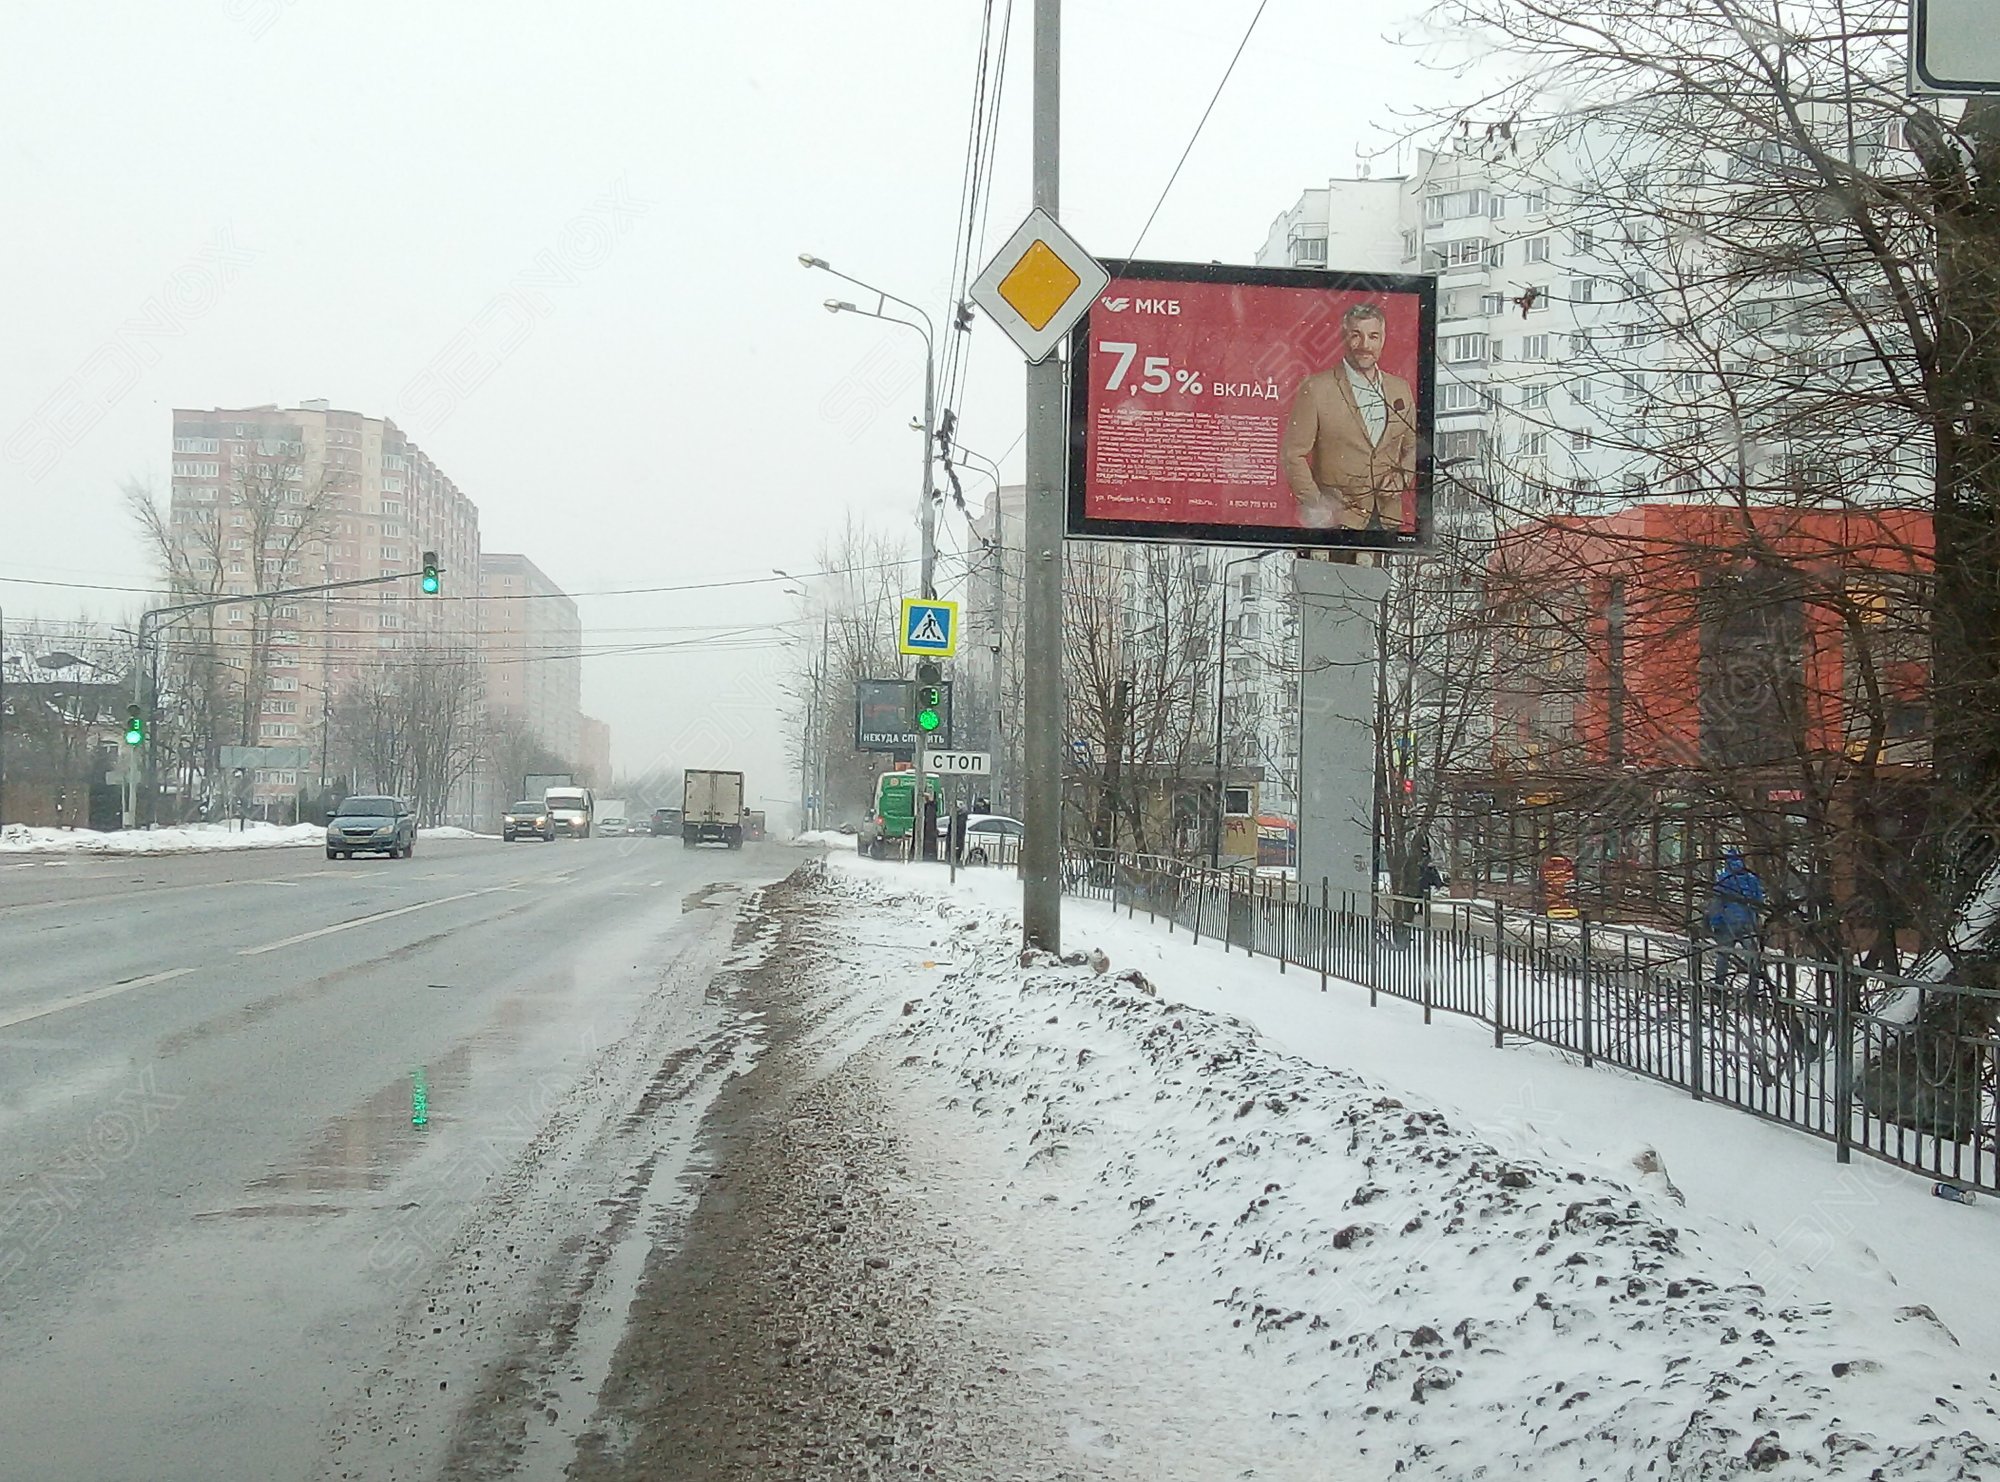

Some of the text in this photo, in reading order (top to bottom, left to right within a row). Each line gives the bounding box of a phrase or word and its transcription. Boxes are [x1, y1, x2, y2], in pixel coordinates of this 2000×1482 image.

[1135, 298, 1181, 316] МКБ
[1099, 341, 1279, 400] 7,5% ВКЛАД
[930, 688, 938, 705] 3
[863, 733, 945, 745] НЕКУДА СПИТЬ
[933, 755, 982, 771] СТОП
